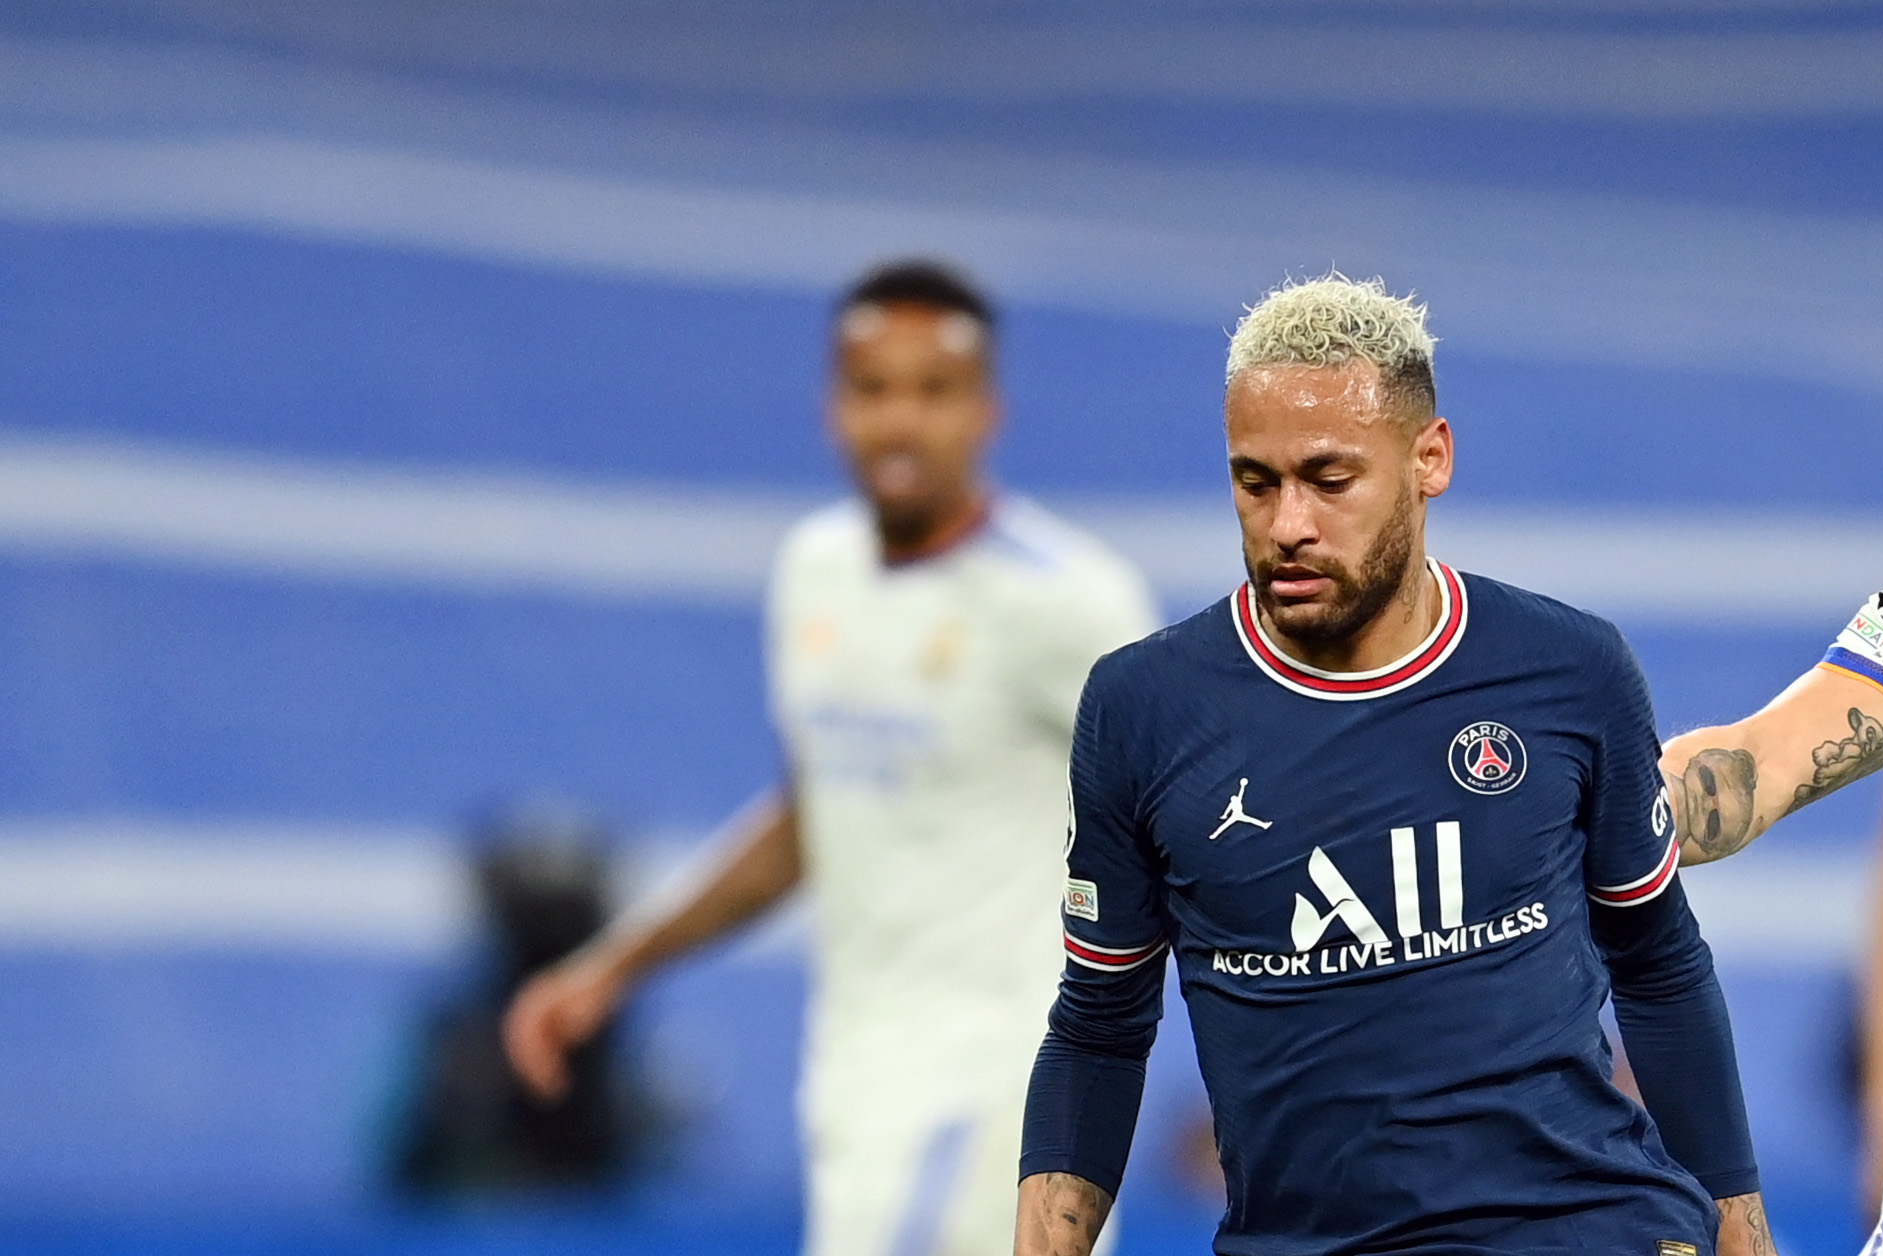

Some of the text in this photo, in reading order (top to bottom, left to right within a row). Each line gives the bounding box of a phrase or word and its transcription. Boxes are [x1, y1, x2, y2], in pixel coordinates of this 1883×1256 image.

[1458, 725, 1510, 747] PARIS
[1212, 902, 1549, 977] ACCOR LIVE LIMITLESS
